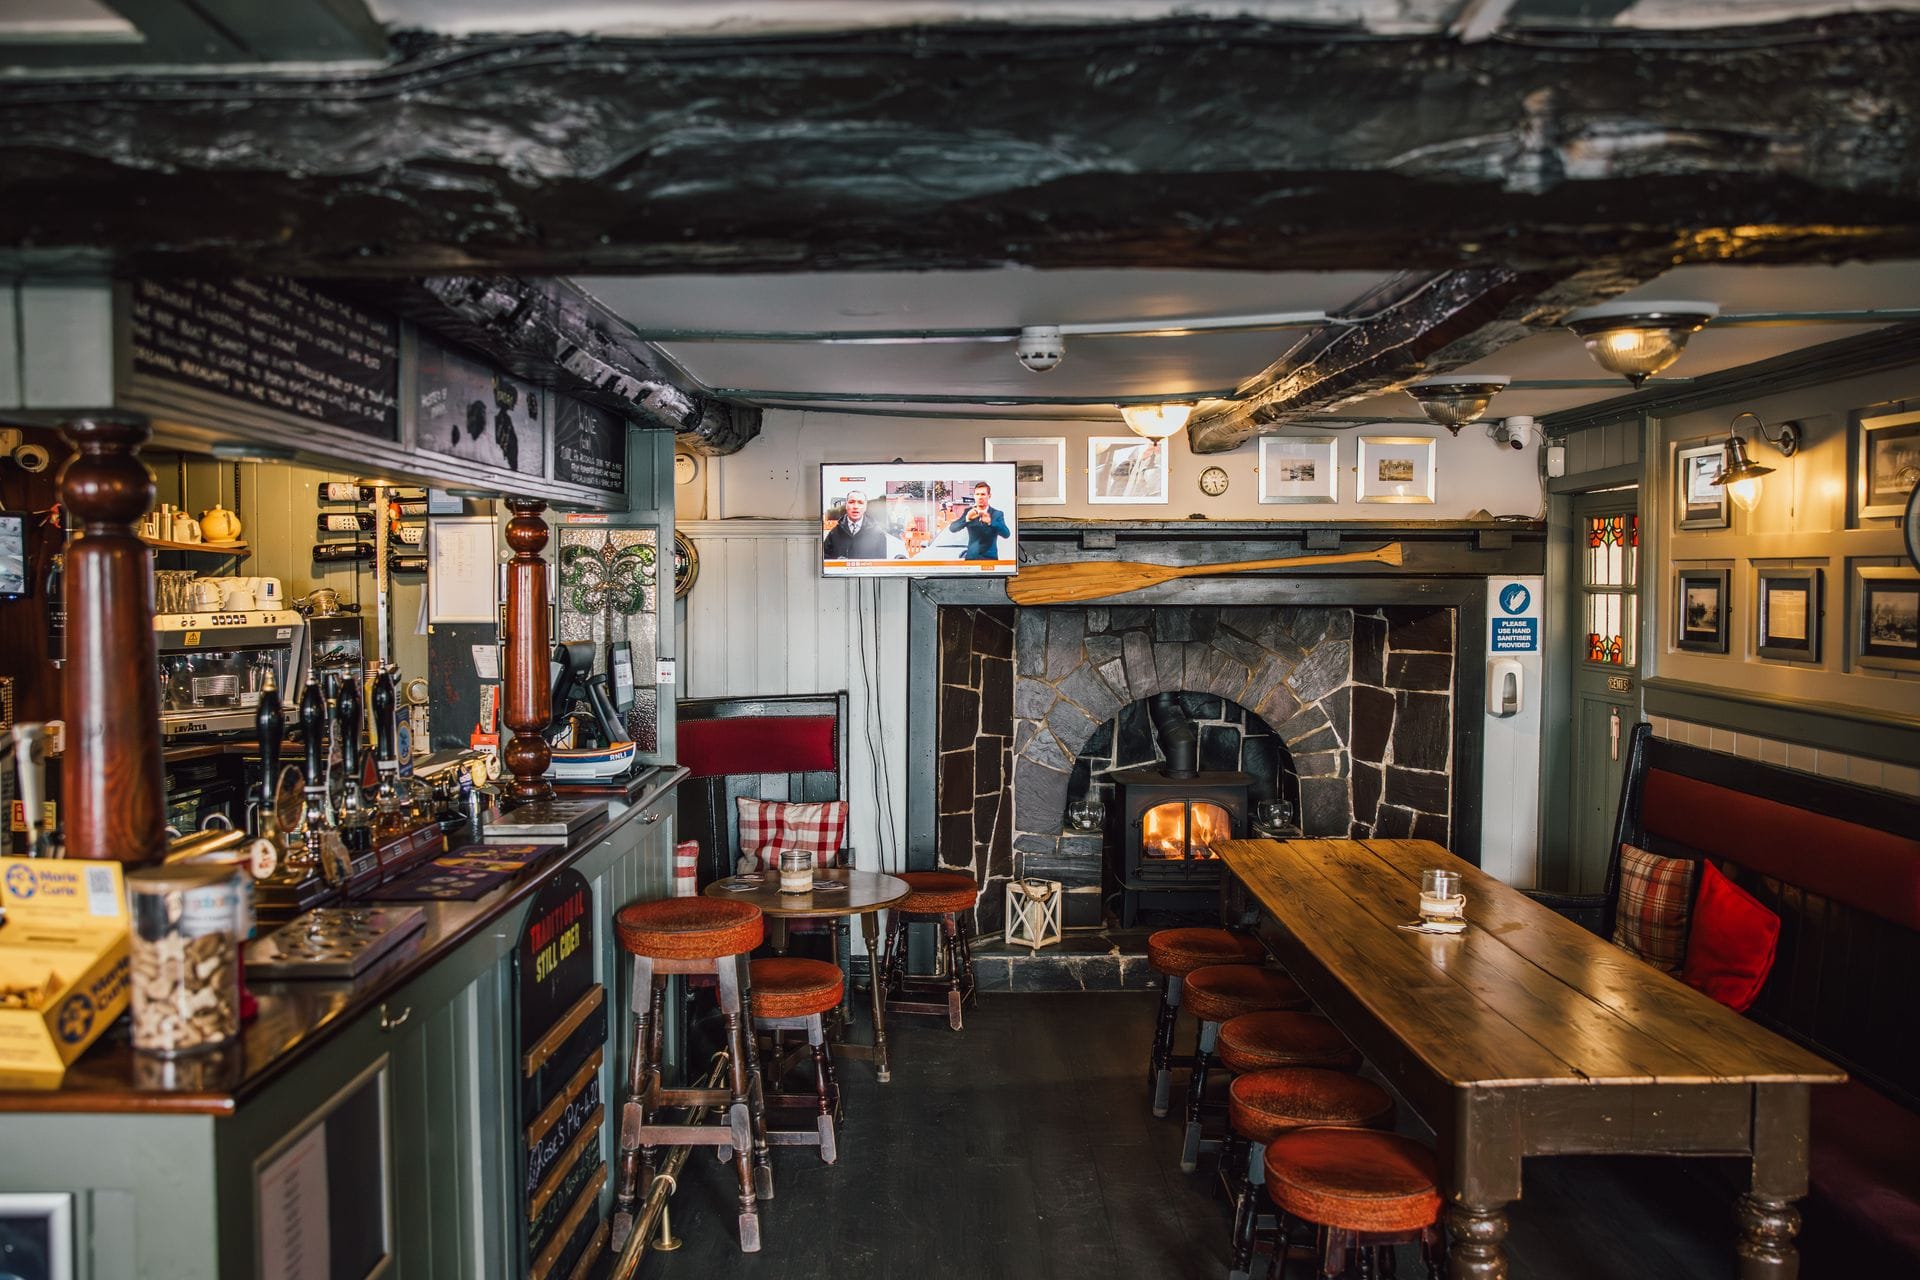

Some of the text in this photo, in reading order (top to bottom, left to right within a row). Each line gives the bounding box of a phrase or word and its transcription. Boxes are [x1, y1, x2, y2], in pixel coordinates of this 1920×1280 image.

[1608, 678, 1630, 691] GENTS
[609, 751, 627, 761] RNLI
[39, 869, 78, 883] Marie
[41, 884, 77, 896] Curie
[536, 922, 580, 984] STILL CIDER
